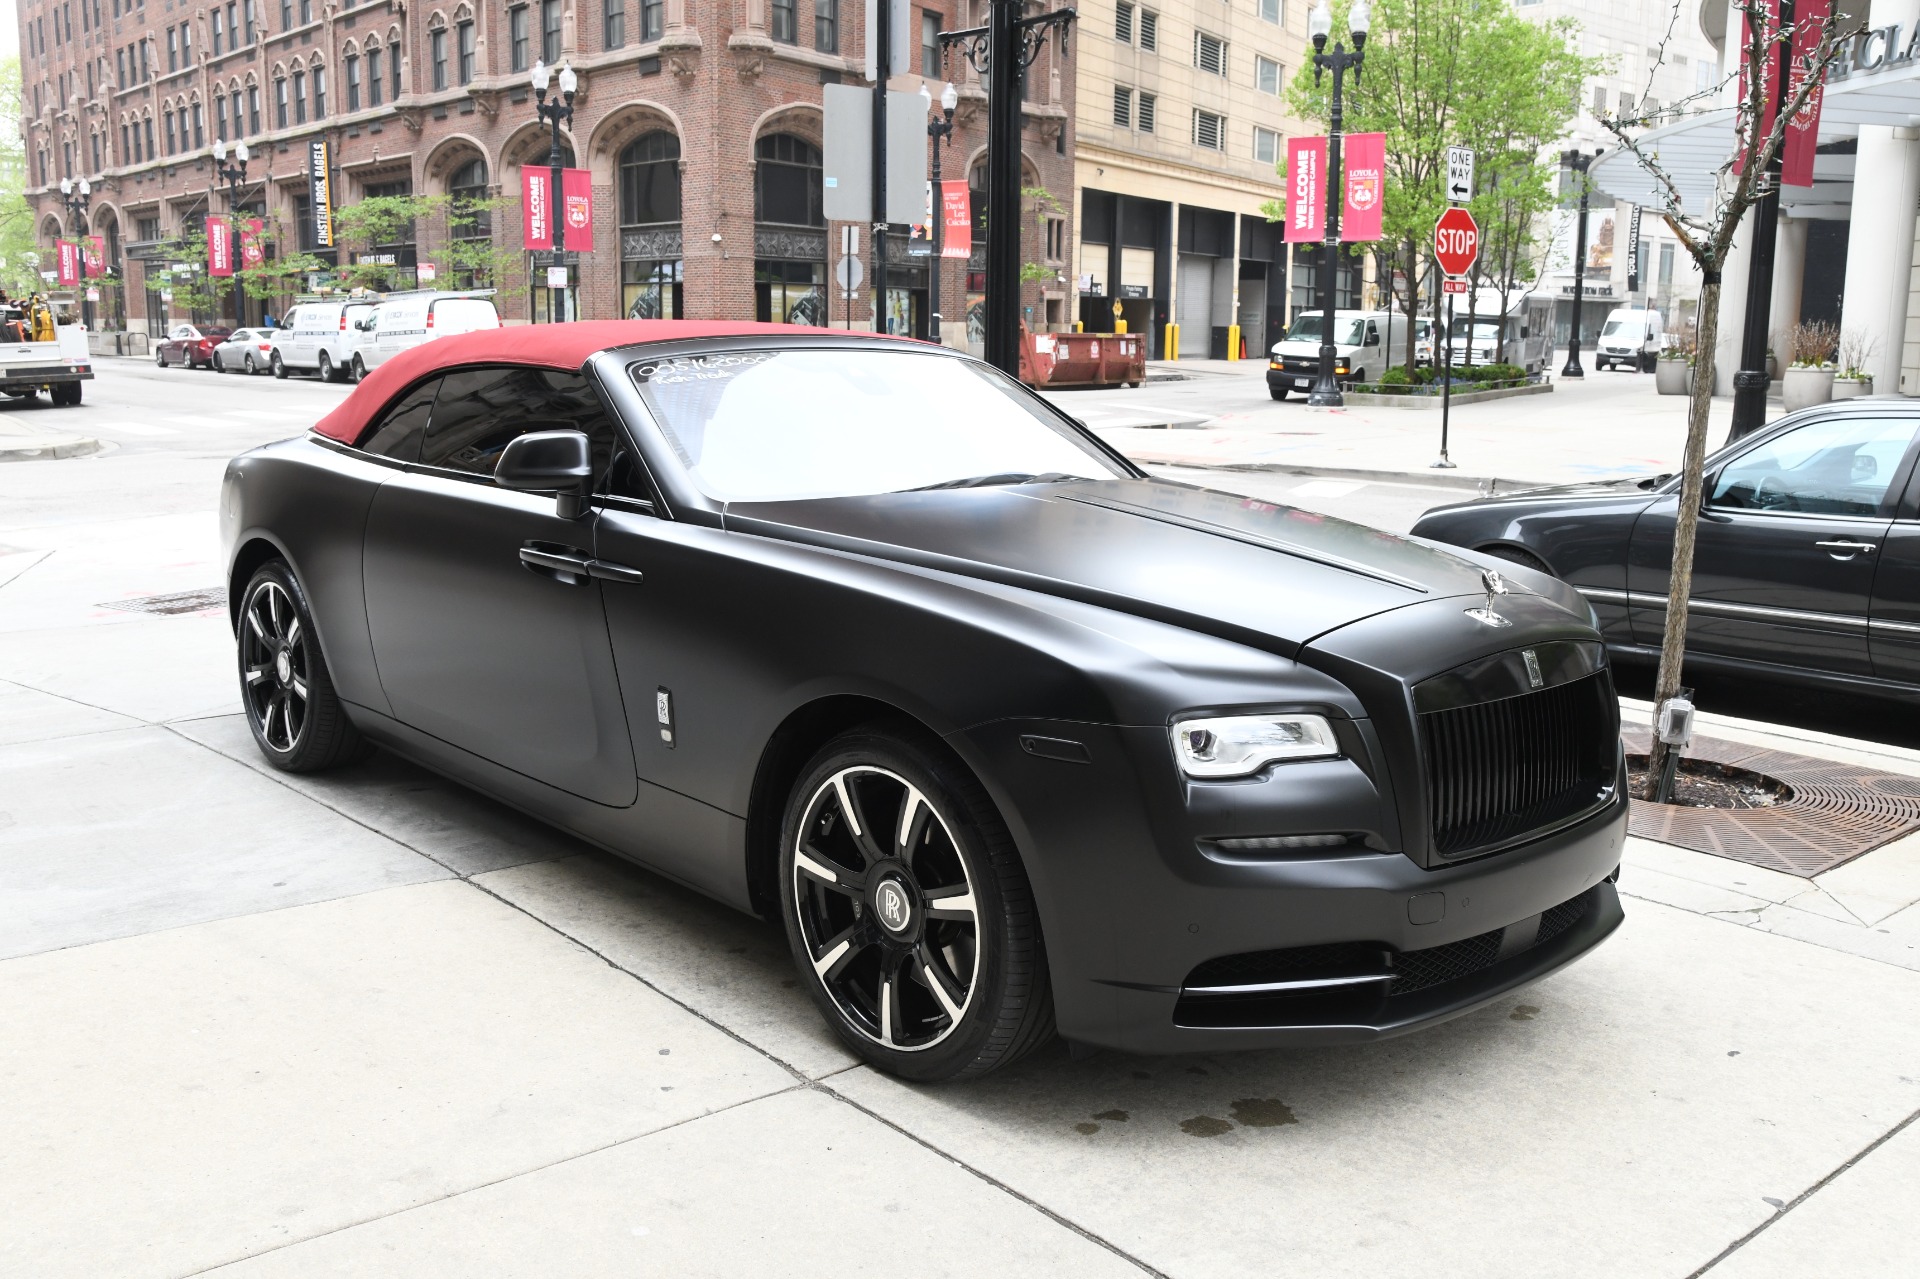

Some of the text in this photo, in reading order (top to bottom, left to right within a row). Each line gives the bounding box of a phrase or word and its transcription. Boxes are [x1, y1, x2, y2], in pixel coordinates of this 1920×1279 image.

[313, 143, 325, 177] BAGELS
[1349, 169, 1379, 177] LOYOLA
[1450, 167, 1471, 180] WAY
[1451, 151, 1471, 166] ONE
[945, 201, 965, 210] David
[1295, 150, 1309, 229] WELCOME
[530, 176, 540, 239] WELCOME
[953, 210, 966, 218] Lee
[317, 205, 329, 245] EINSTEIN
[1437, 228, 1476, 255] STOP
[1627, 205, 1640, 277] ORDSTROM rack
[61, 245, 71, 280] WELCOME
[213, 225, 222, 269] WELCOME
[1444, 283, 1465, 292] ALL WAY
[885, 888, 901, 922] RR
